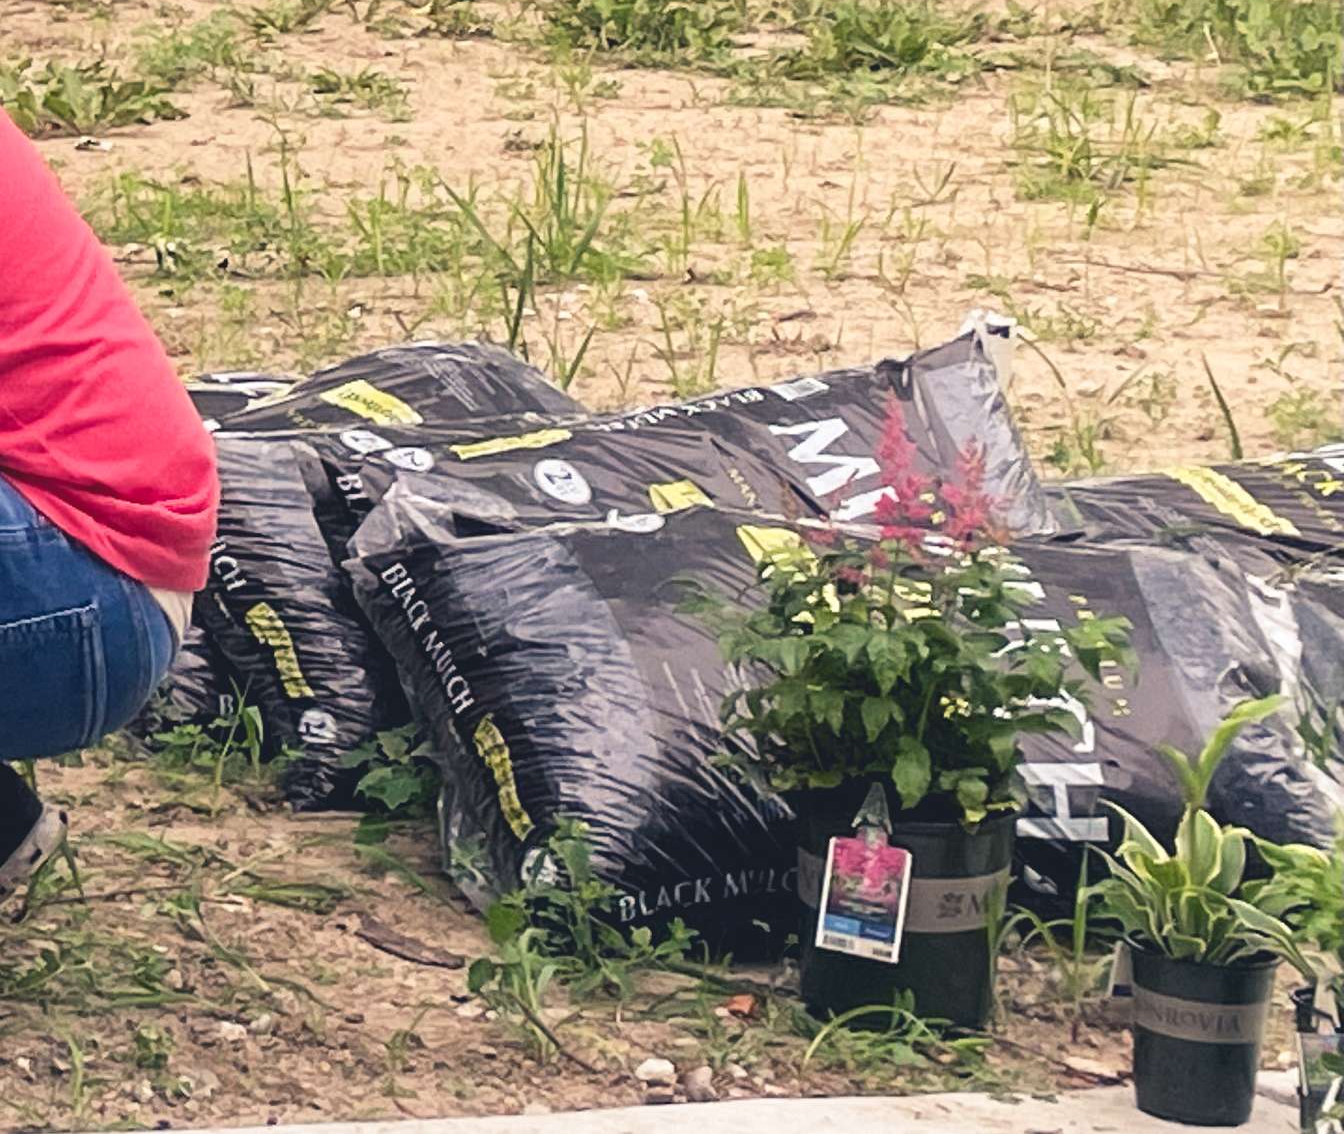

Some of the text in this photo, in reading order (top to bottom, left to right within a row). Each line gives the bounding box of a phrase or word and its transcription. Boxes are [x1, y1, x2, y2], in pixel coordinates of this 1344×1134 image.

[680, 387, 765, 417] BLACK
[381, 561, 475, 715] BLACK MULCH
[619, 876, 712, 923] BLACK
